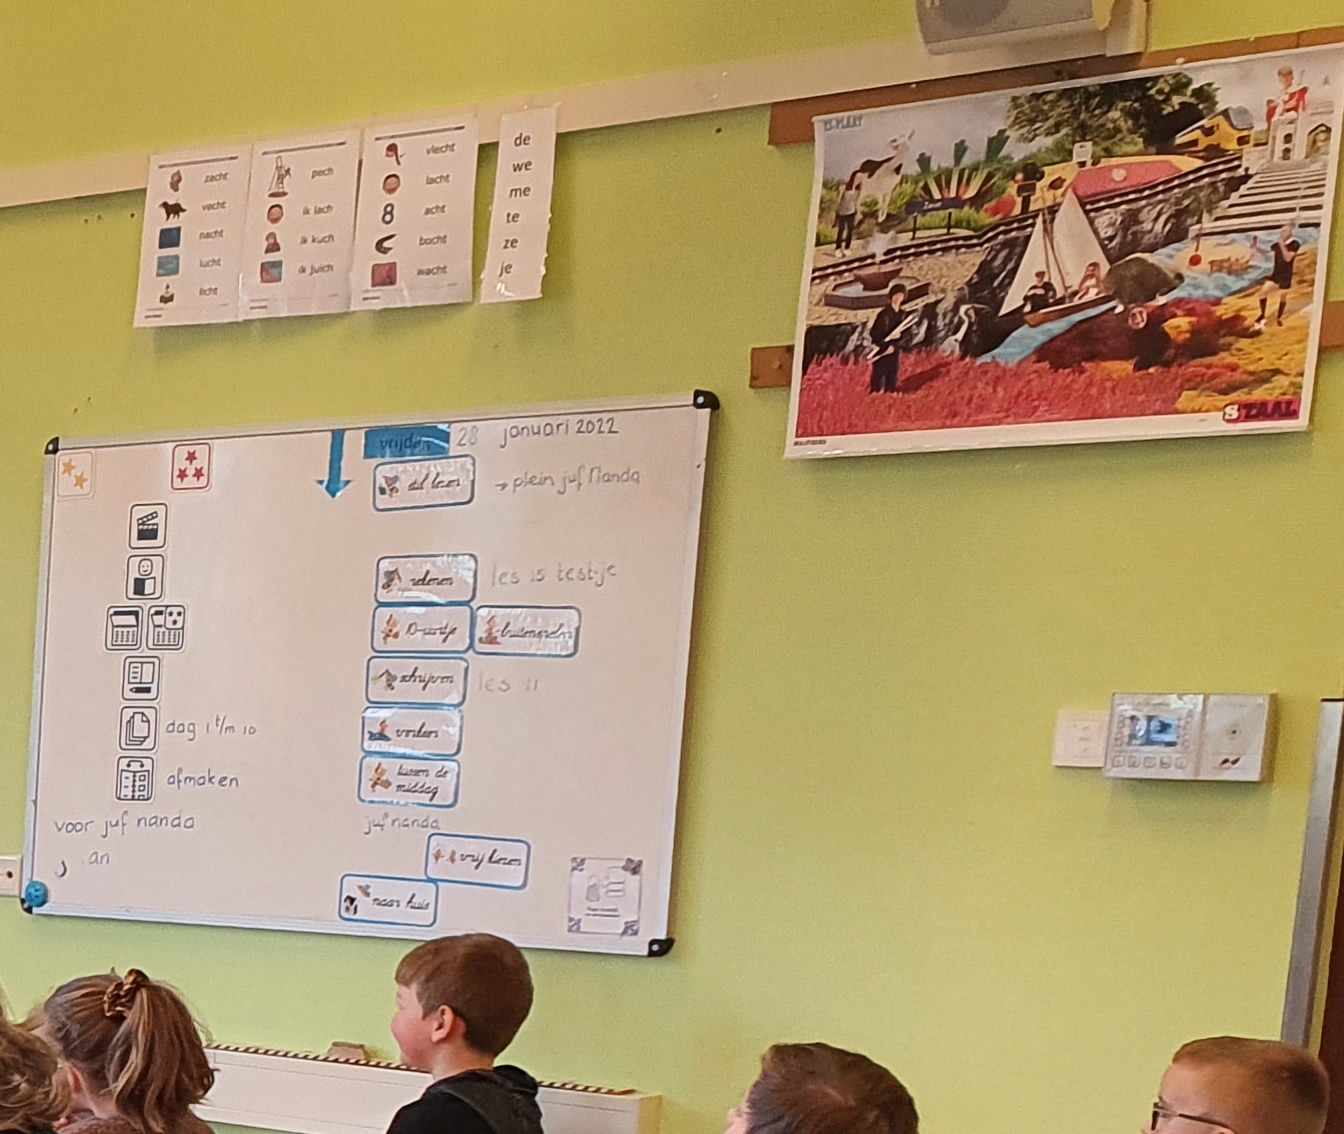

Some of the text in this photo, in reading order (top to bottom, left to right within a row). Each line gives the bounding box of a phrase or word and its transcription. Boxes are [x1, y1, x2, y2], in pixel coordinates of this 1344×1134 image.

[514, 132, 531, 147] de
[425, 143, 457, 155] vlecht
[512, 159, 533, 172] we
[204, 172, 229, 183] zacht
[311, 167, 334, 179] pech
[425, 173, 450, 185] lacht
[509, 185, 531, 199] me
[202, 201, 226, 211] vacht
[302, 204, 334, 216] ik lach
[424, 203, 446, 215] acht
[381, 202, 395, 225] 8
[506, 211, 520, 224] te
[199, 229, 224, 240] nacht
[300, 234, 334, 245] ik kuch
[418, 234, 447, 246] bocht
[502, 236, 519, 249] ze
[199, 258, 221, 268] lucht
[499, 262, 513, 277] je
[298, 264, 333, 276] ik juich
[416, 264, 447, 276] wacht
[199, 286, 218, 296] licht
[457, 428, 479, 447] 28
[499, 421, 569, 448] januari
[575, 417, 619, 435] 2022
[512, 472, 555, 493] plein
[557, 464, 587, 495] juf
[491, 560, 520, 587] les
[530, 568, 545, 583] 15
[479, 671, 511, 692] les
[166, 719, 197, 741] dag
[215, 714, 236, 736] t/m
[243, 725, 258, 736] 10
[435, 765, 449, 779] de
[167, 767, 240, 791] afmaken
[53, 810, 195, 839] voor juf nanda
[363, 813, 390, 835] juf
